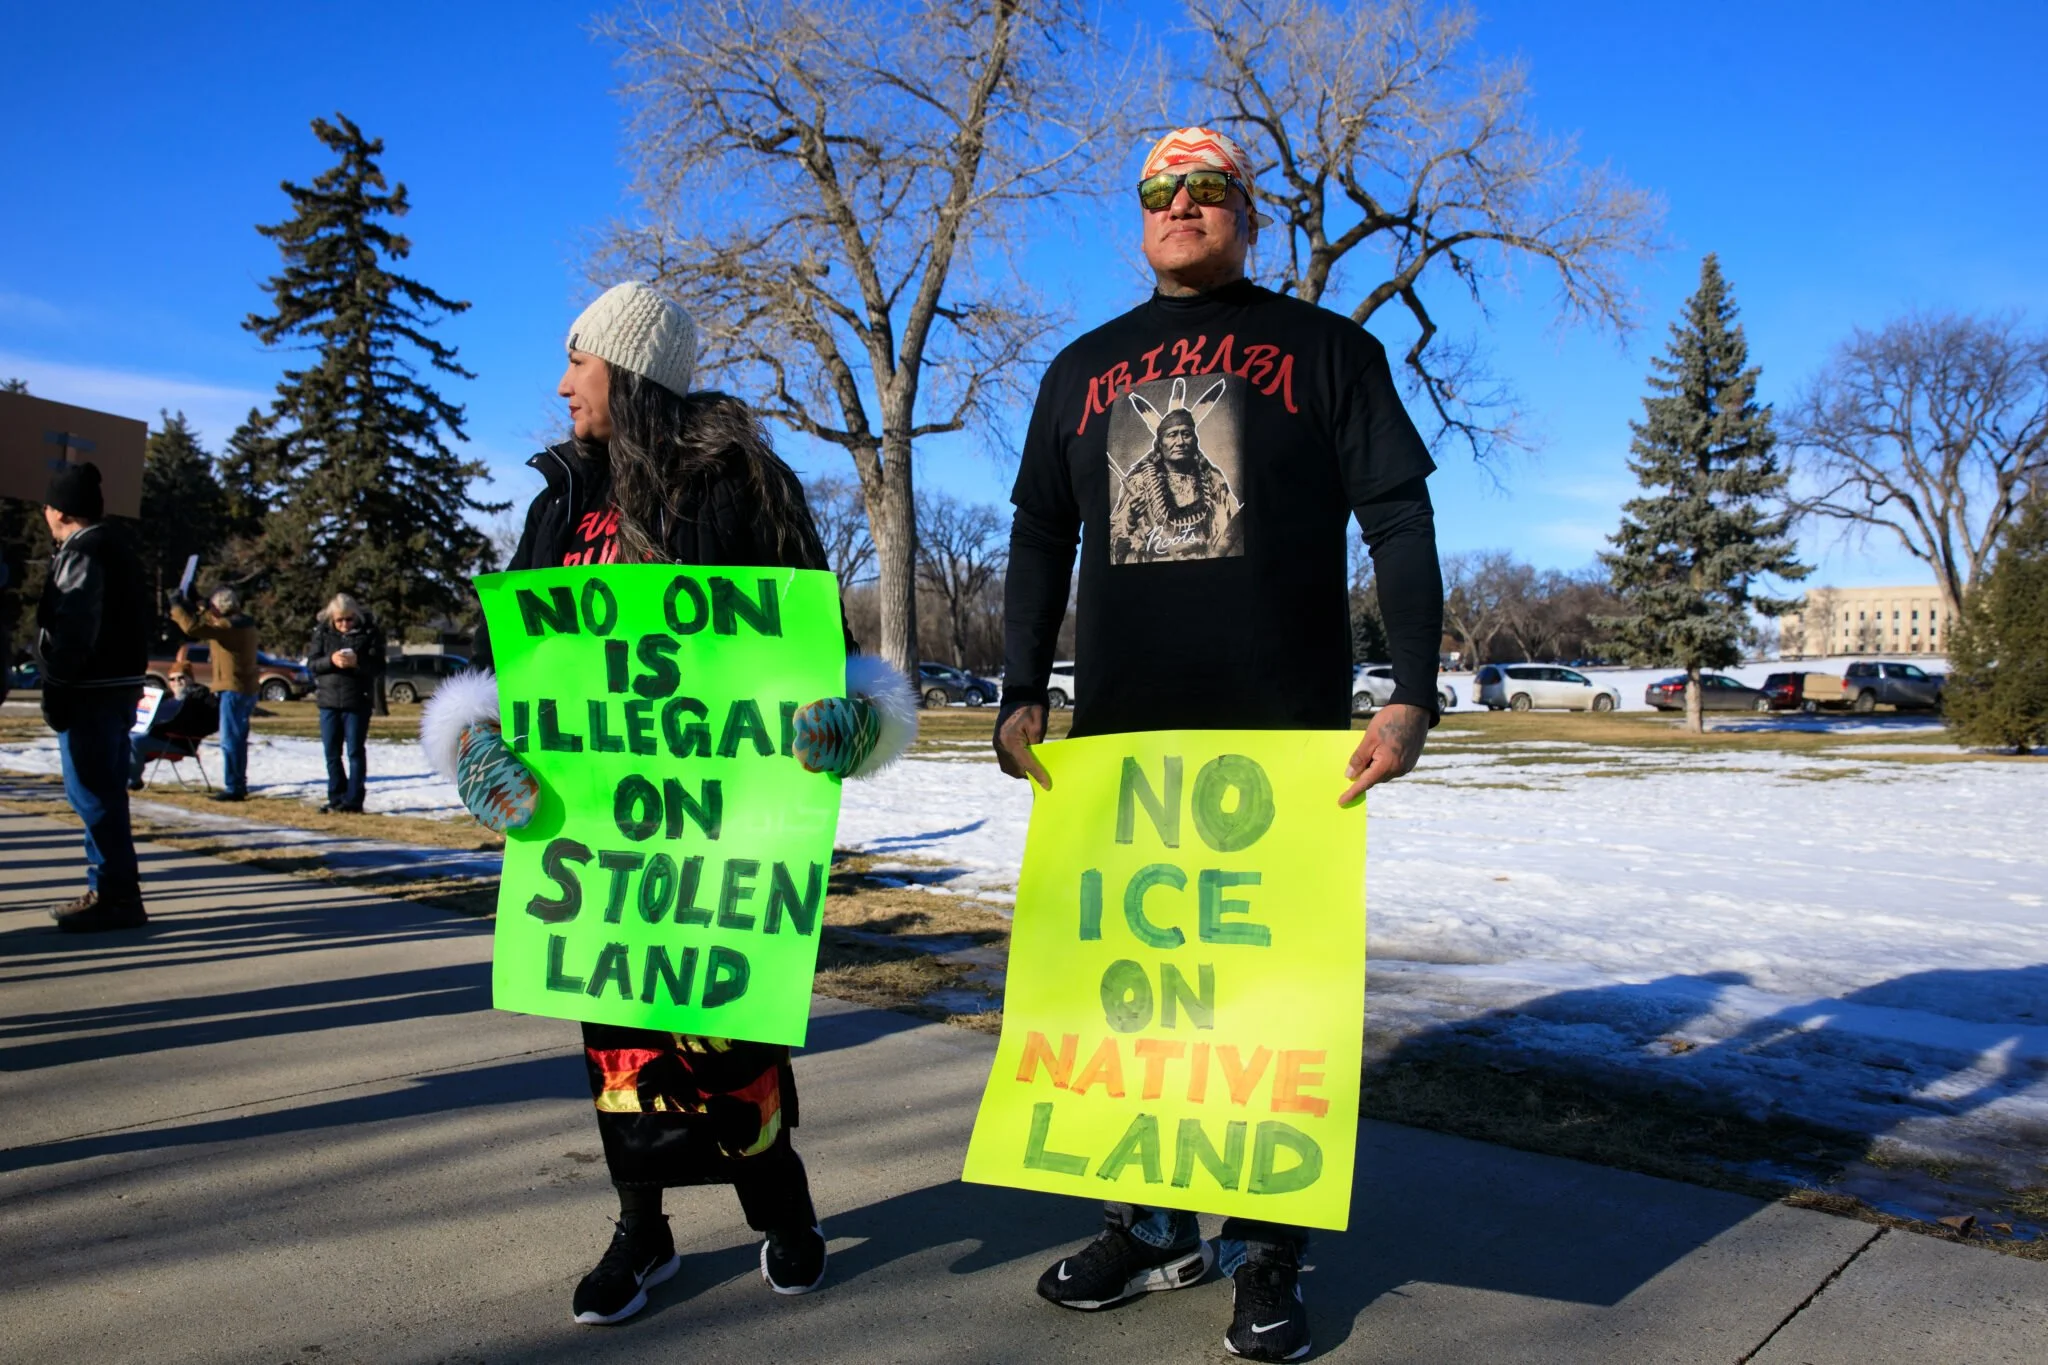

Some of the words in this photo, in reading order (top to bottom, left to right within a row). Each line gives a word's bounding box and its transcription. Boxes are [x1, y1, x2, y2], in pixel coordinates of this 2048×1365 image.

[1076, 334, 1298, 436] ARIKARA
[1146, 524, 1201, 554] Roots
[515, 577, 618, 637] NO
[663, 574, 783, 638] ON
[605, 633, 682, 700] IS
[613, 773, 723, 841] ON
[1115, 753, 1276, 853] NO
[525, 838, 824, 936] STOLEN
[1079, 863, 1272, 950] ICE
[546, 933, 751, 1009] LAND
[1100, 958, 1215, 1034] ON
[1016, 1031, 1330, 1117] NATIVE
[1023, 1101, 1323, 1195] LAND
